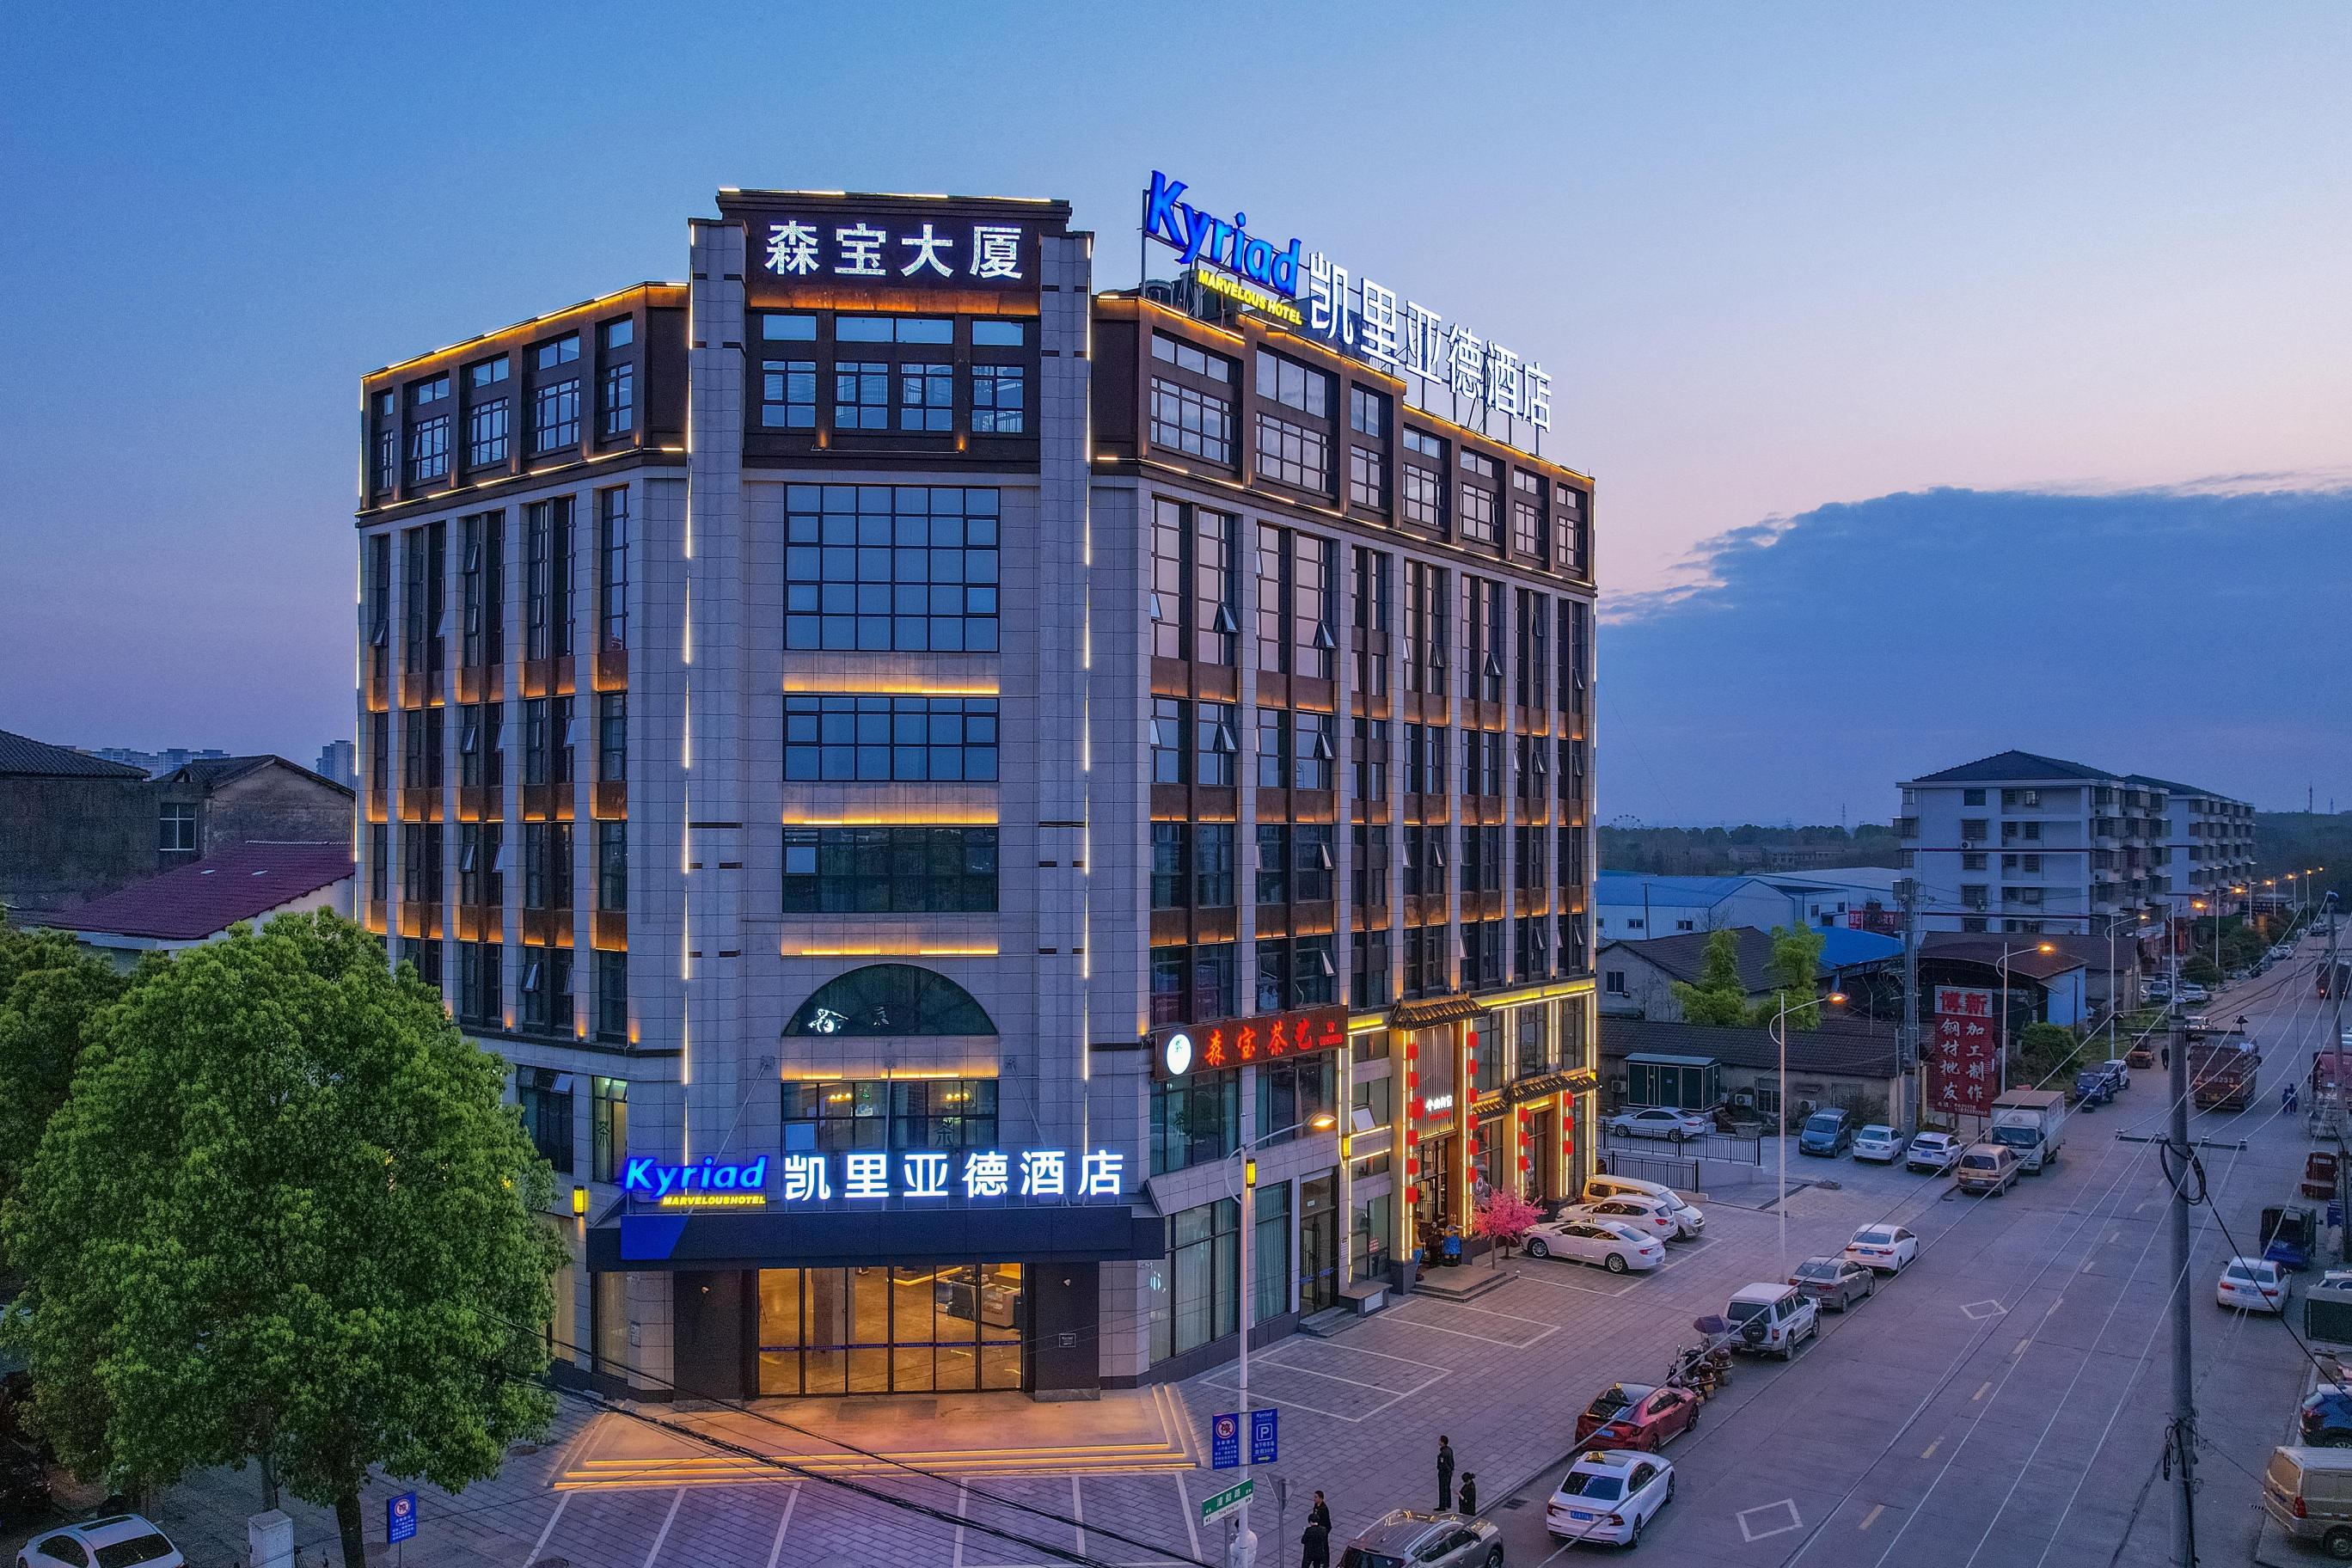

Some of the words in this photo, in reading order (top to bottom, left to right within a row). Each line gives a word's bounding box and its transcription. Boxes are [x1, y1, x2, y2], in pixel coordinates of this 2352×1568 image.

[765, 220, 1023, 279] 森宝大厦
[1145, 170, 1302, 296] Kyriad
[1196, 268, 1266, 310] MARVELOUS
[1266, 298, 1302, 326] HOTEL
[1309, 251, 1552, 433] 凯里亚德酒店
[1204, 1018, 1314, 1067] 森宝茶艺
[1966, 1021, 1986, 1102] 加工制作
[622, 1154, 769, 1198] Kyriad
[662, 1196, 729, 1205] MARVELOUS
[729, 1195, 766, 1205] HOTEL
[784, 1148, 1124, 1201] 凯里亚德酒店
